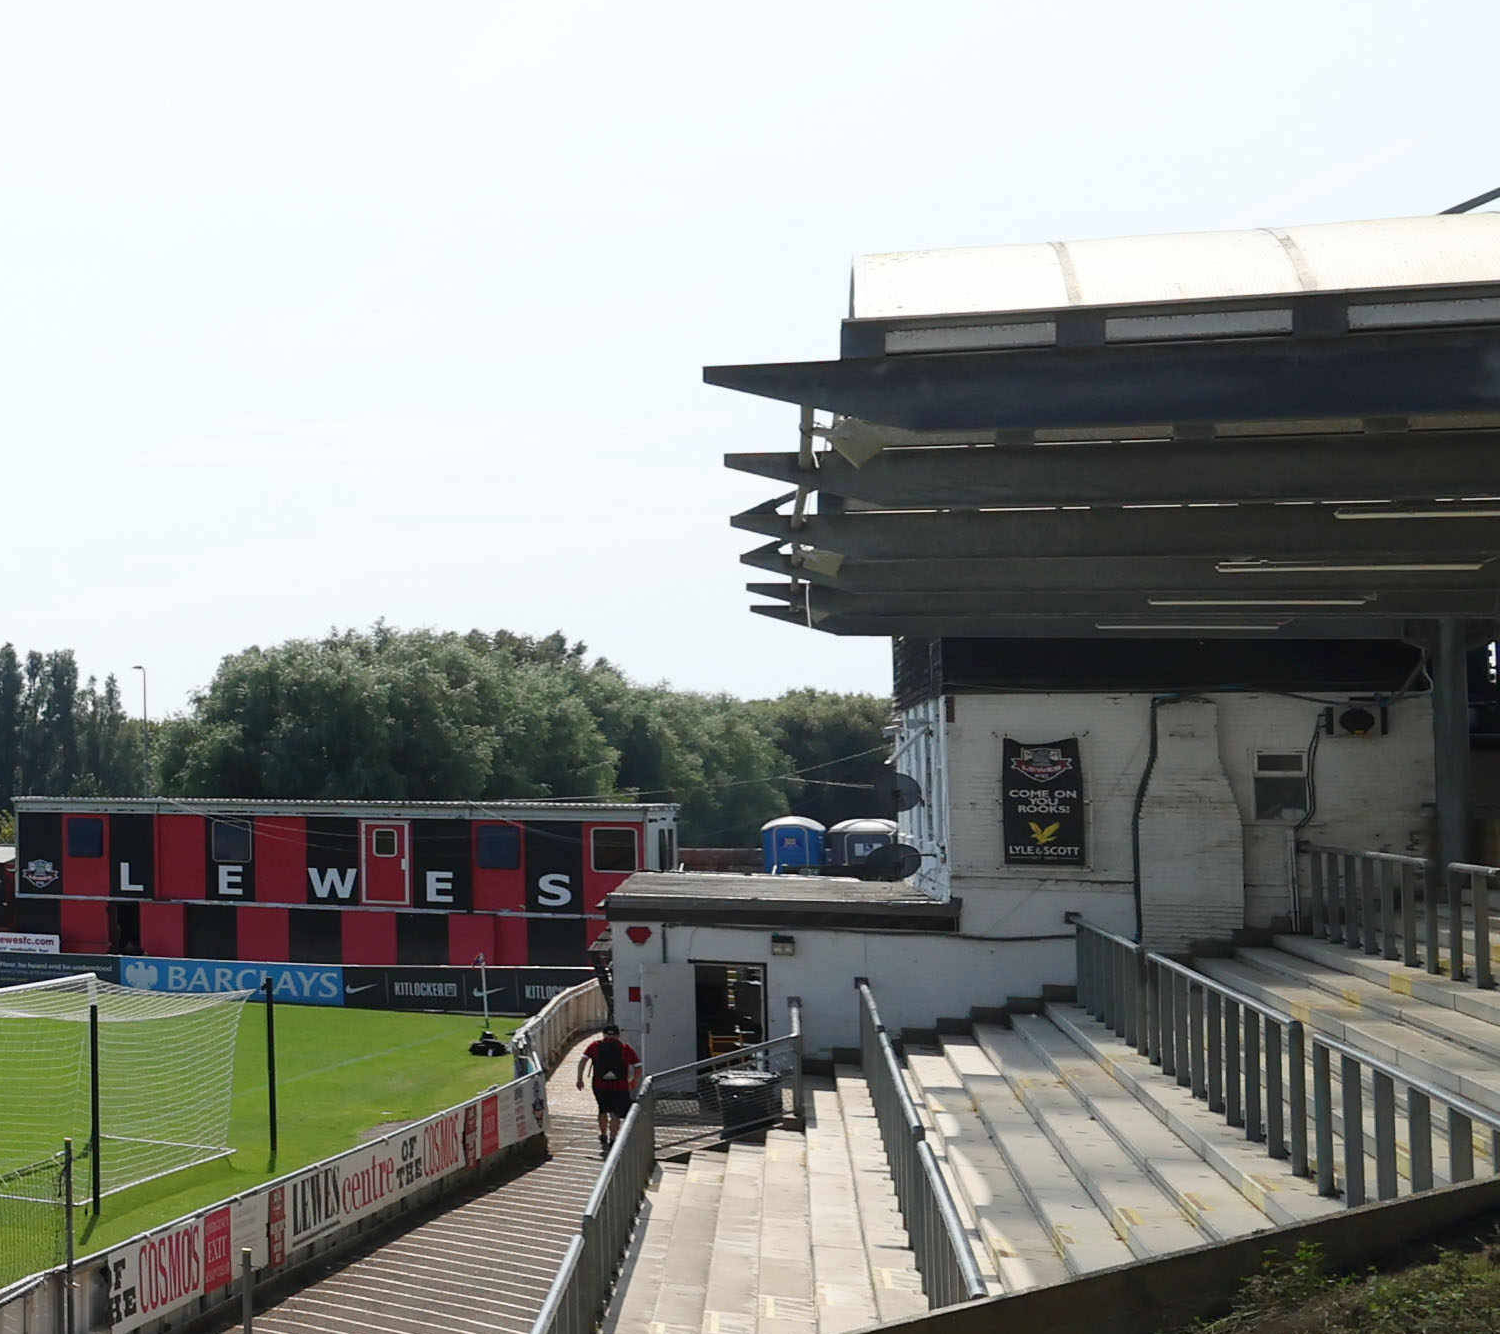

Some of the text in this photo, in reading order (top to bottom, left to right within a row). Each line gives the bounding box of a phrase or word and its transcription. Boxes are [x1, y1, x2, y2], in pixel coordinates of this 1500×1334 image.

[1008, 789, 1078, 799] COME ON
[1029, 797, 1059, 805] YOU
[1017, 805, 1071, 814] ROOKS!
[168, 966, 339, 998] BARCLAYS
[401, 1135, 418, 1162] OF
[396, 1157, 423, 1189] THE
[293, 1166, 341, 1236] LEWES
[342, 1155, 395, 1214] centre
[109, 1286, 137, 1328] HE
